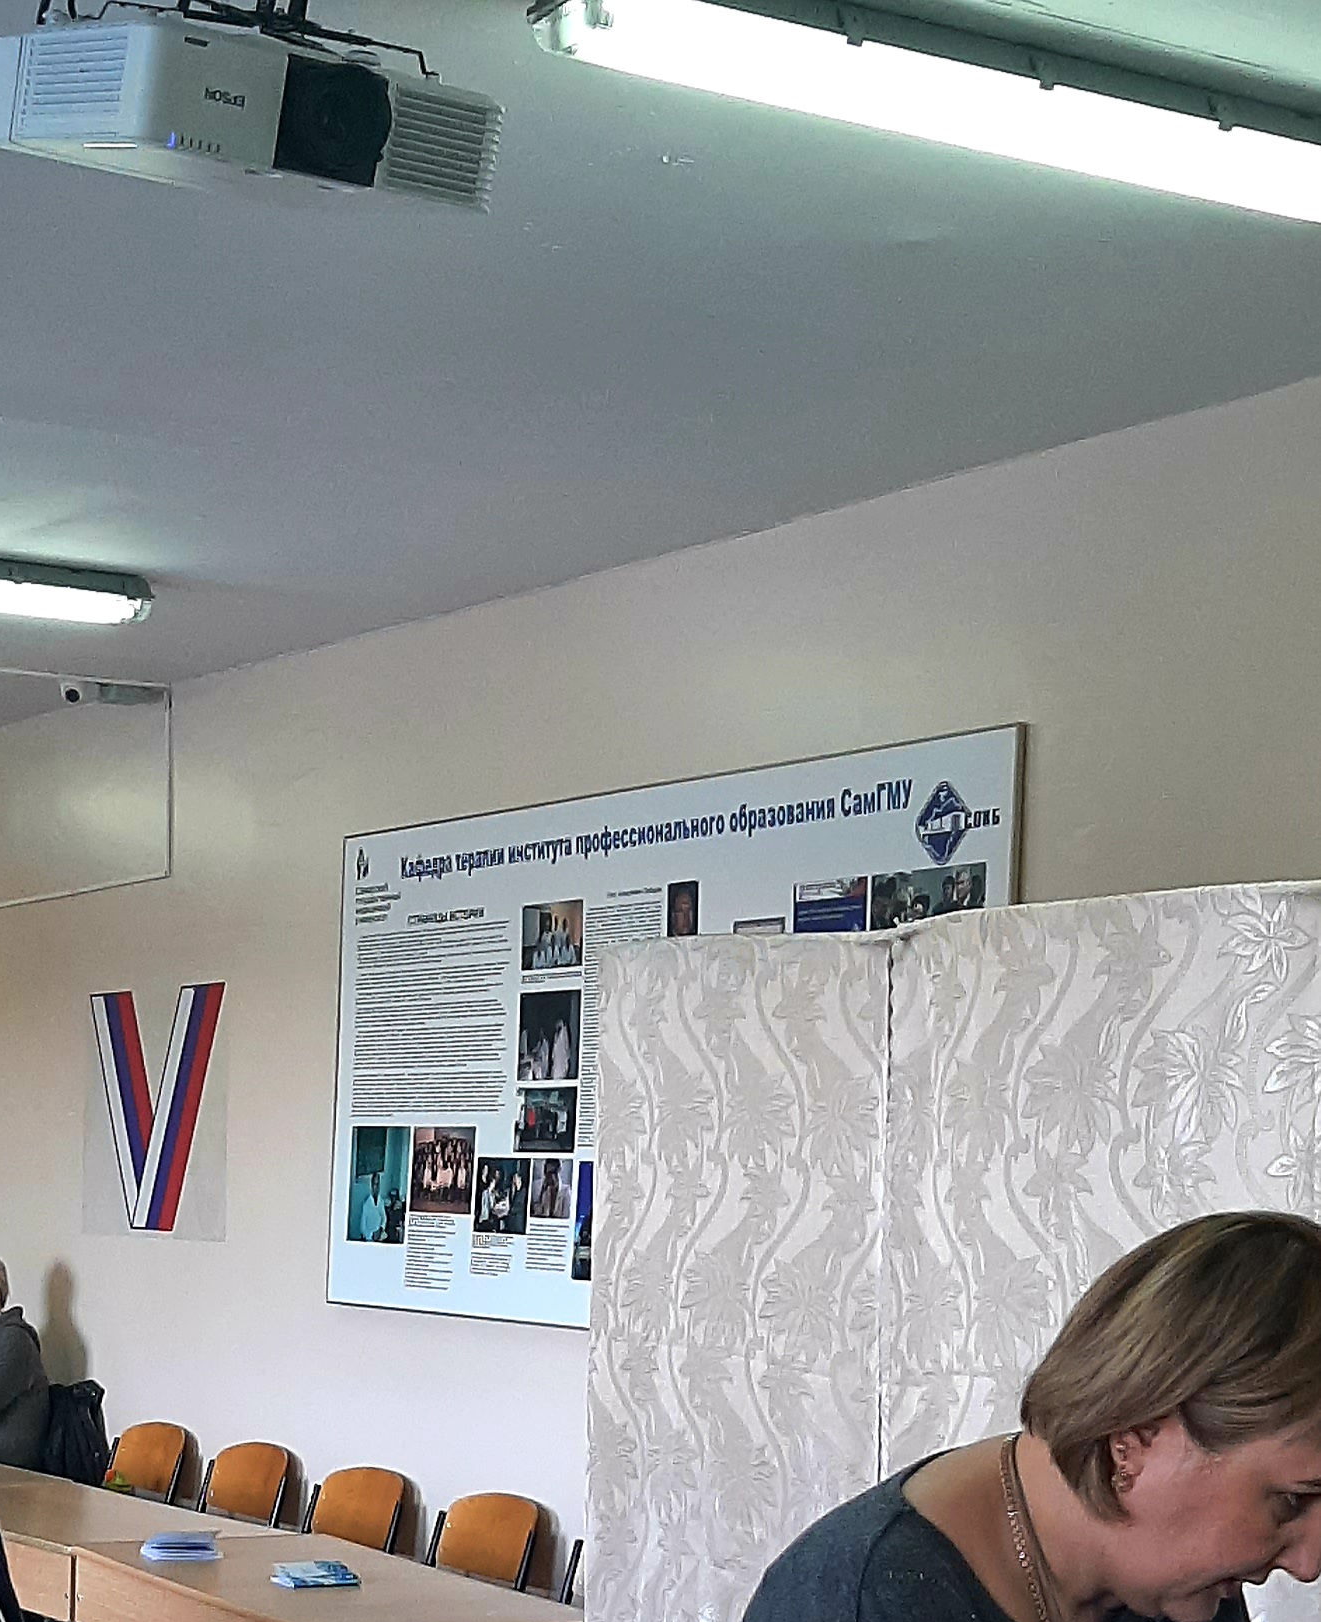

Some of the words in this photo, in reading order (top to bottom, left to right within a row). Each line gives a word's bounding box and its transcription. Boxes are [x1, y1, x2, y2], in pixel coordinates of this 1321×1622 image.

[205, 88, 246, 110] EPSON
[400, 853, 453, 882] Кафедра
[455, 848, 504, 877] терапии
[508, 837, 572, 865] института
[576, 814, 725, 860] профессионального
[729, 797, 835, 838] образования
[840, 779, 913, 817] СамГМУ
